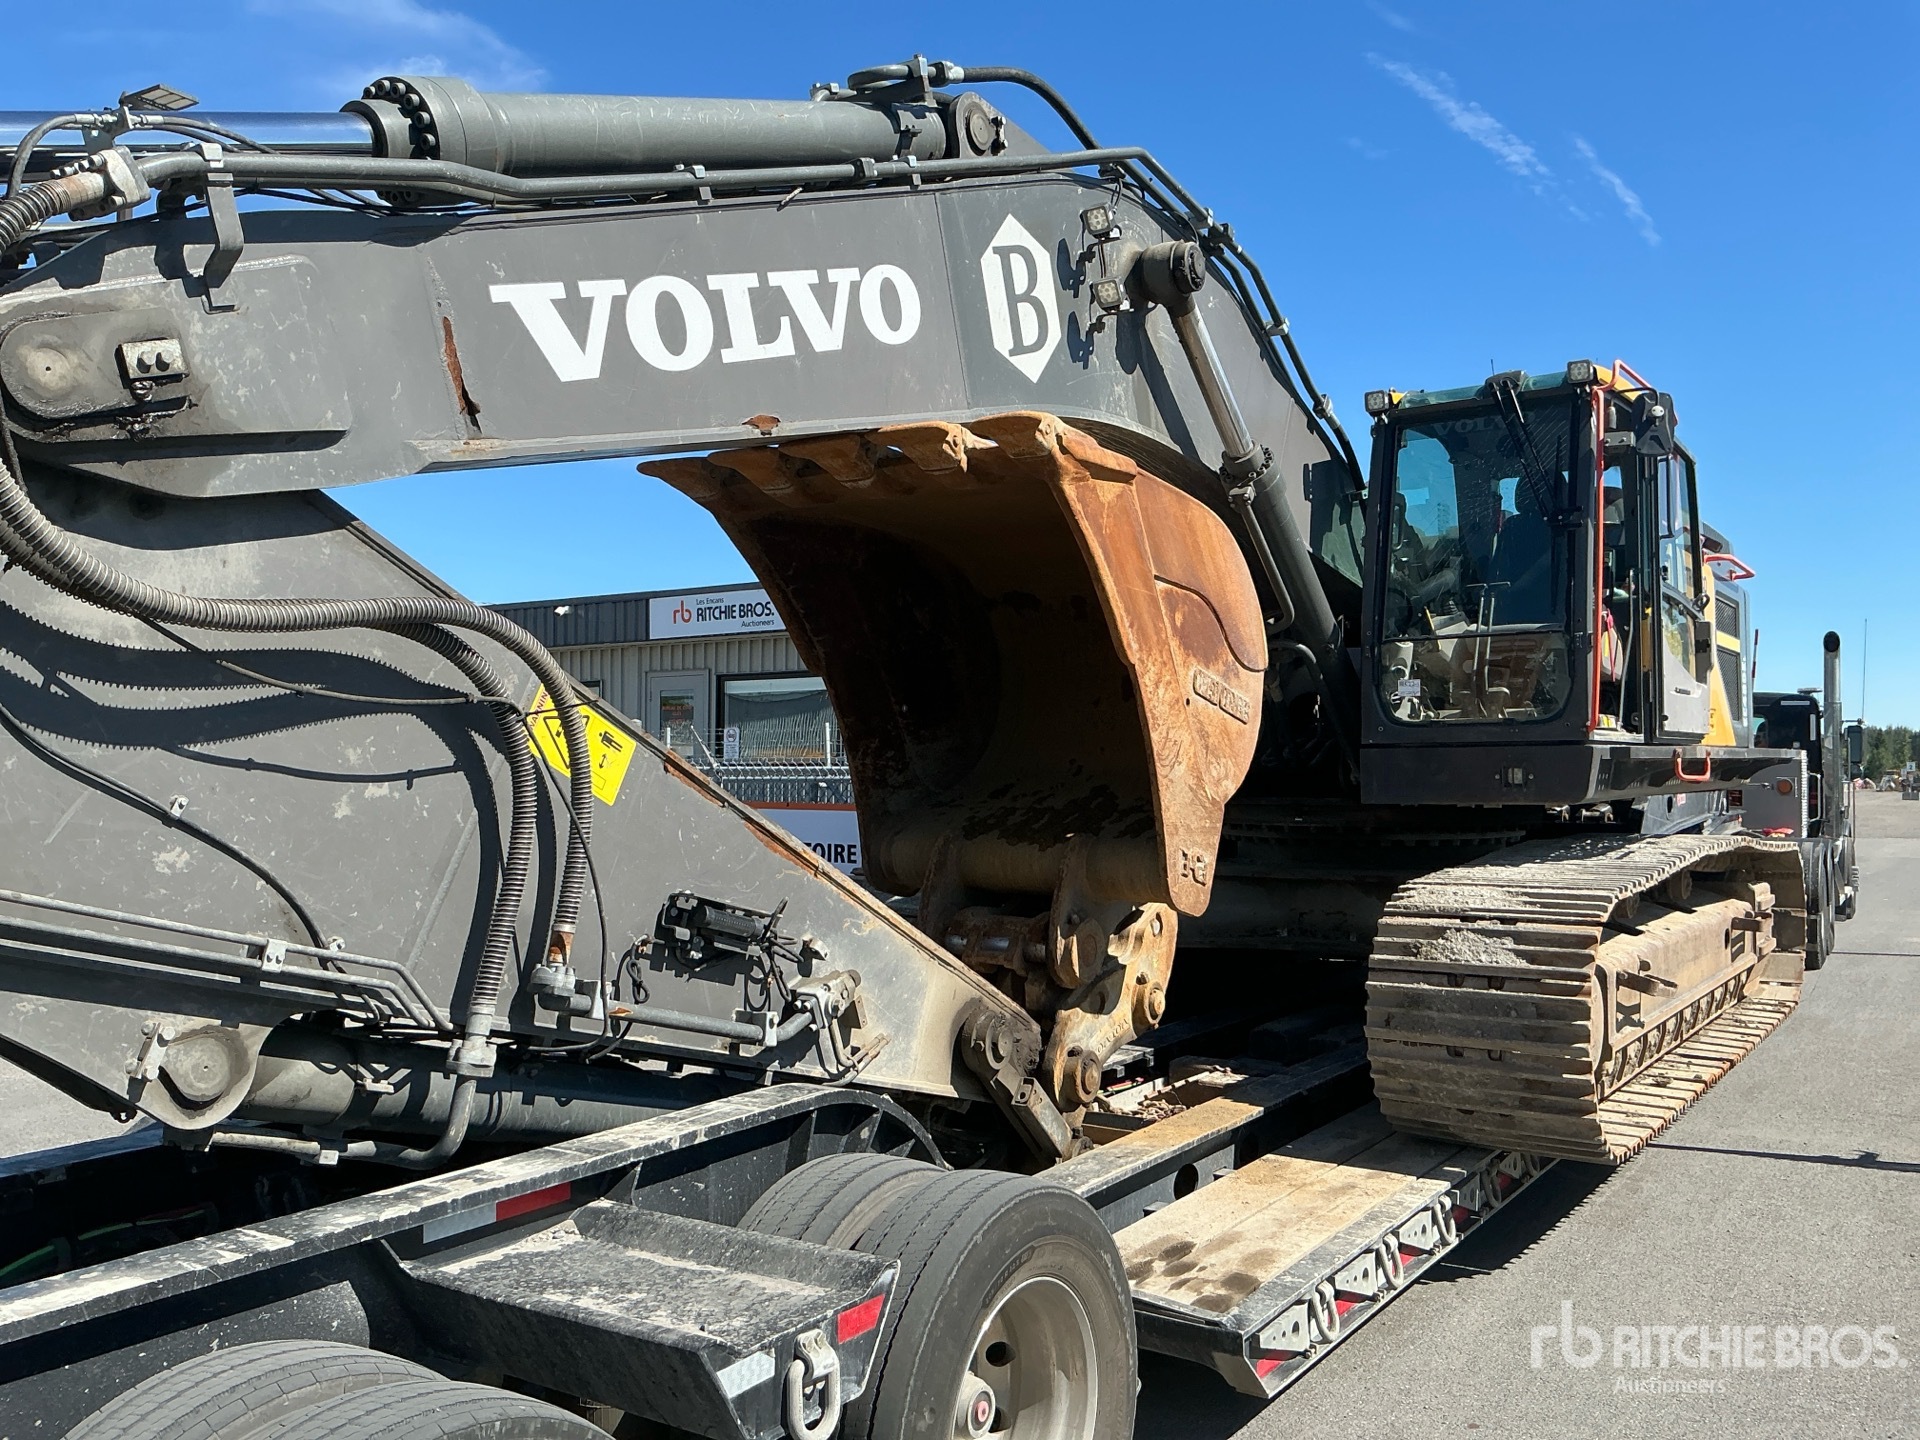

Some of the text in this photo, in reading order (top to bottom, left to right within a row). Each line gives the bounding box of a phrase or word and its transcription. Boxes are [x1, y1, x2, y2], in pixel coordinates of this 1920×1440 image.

[992, 244, 1049, 357] B
[489, 264, 922, 383] VOLVO
[672, 600, 692, 624] rb
[695, 597, 724, 606] Les Encans
[696, 601, 775, 623] RITCHIE BROS.
[740, 619, 775, 628] Auctioneers
[803, 842, 858, 864] OIRE
